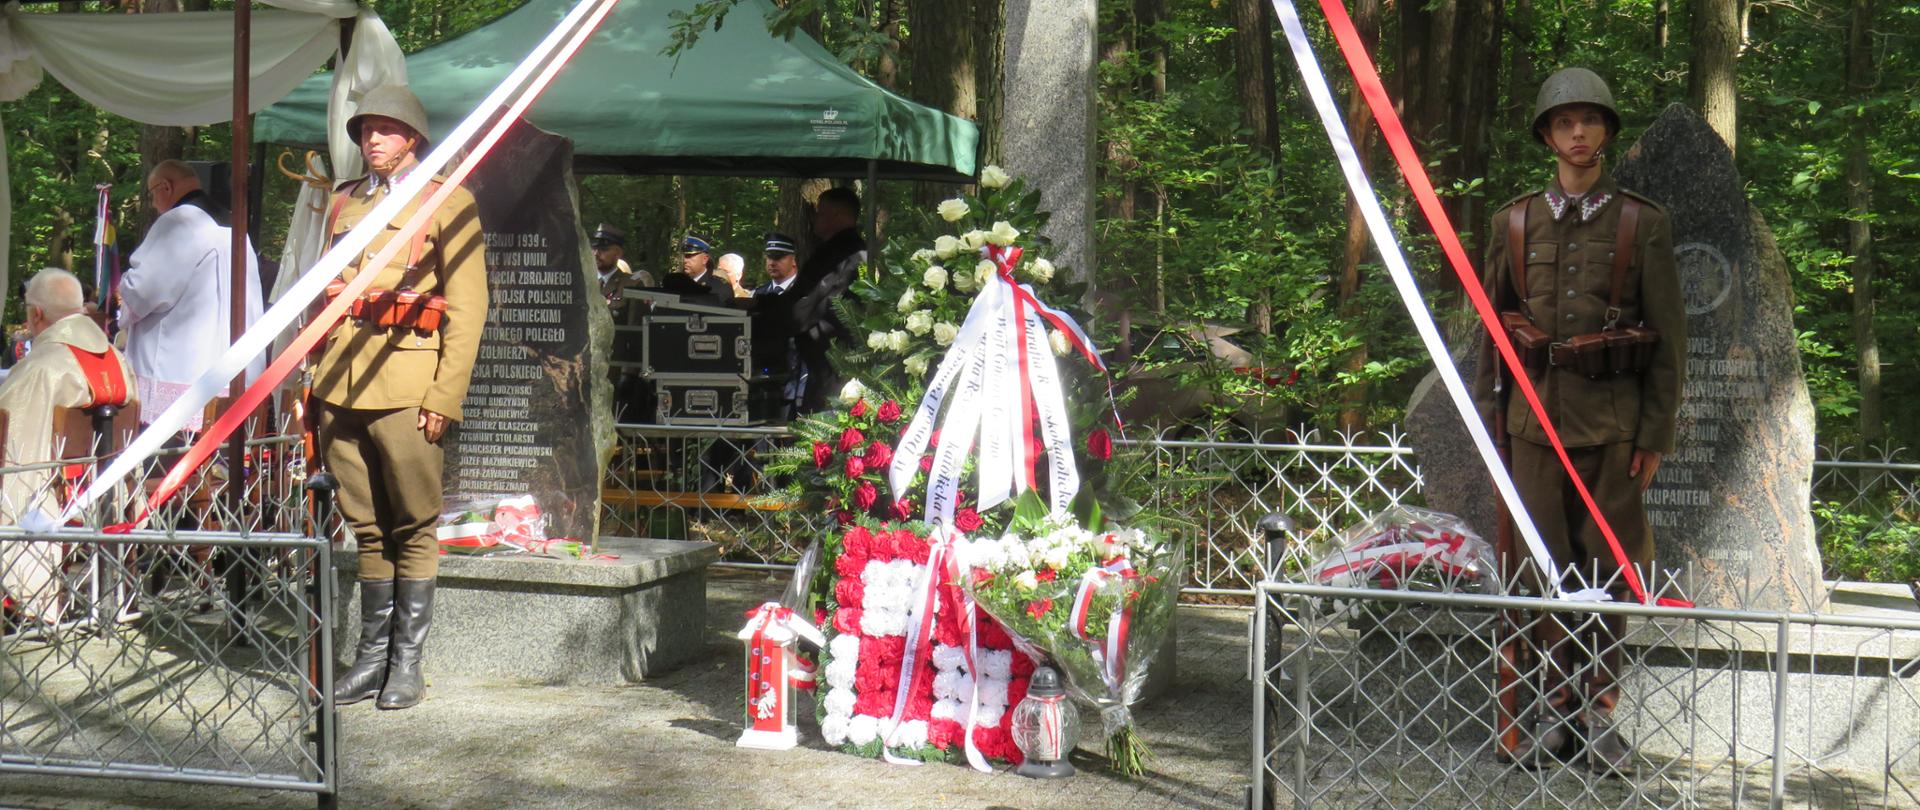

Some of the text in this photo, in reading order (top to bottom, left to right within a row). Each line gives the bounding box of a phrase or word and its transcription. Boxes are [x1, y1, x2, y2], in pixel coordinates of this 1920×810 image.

[517, 234, 540, 247] 1939
[503, 252, 521, 266] WSI
[523, 252, 548, 266] UNIN
[488, 271, 572, 285] ARCIA ZBROJNEGO
[493, 289, 573, 304] WOJSK POLSKICH
[502, 308, 562, 323] NIEMIECKIMI
[525, 328, 565, 342] POLEGŁO
[473, 364, 543, 379] SKA POLSKIEGO
